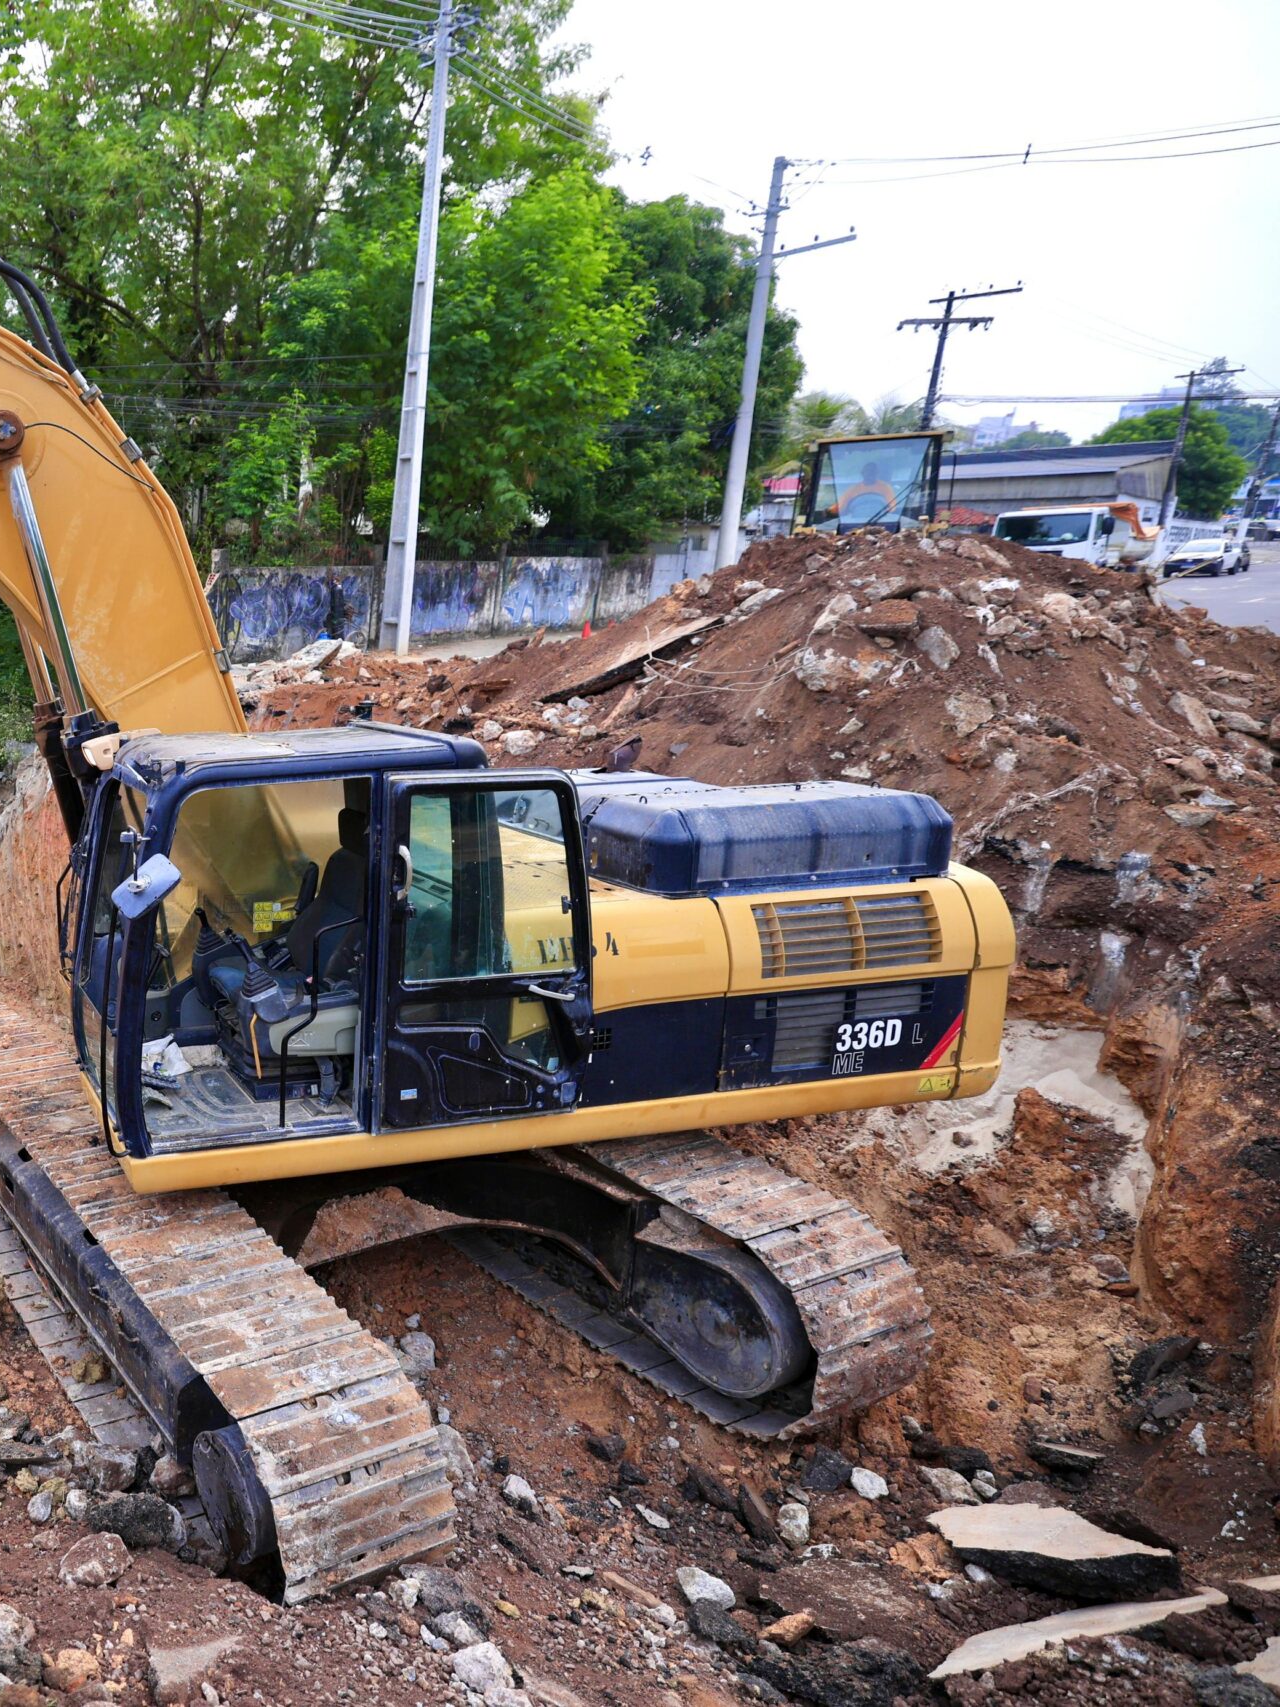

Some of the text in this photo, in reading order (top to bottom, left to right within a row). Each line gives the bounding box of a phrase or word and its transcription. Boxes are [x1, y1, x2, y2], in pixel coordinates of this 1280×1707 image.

[836, 1019, 923, 1051] 336D L
[832, 1051, 864, 1075] ME
